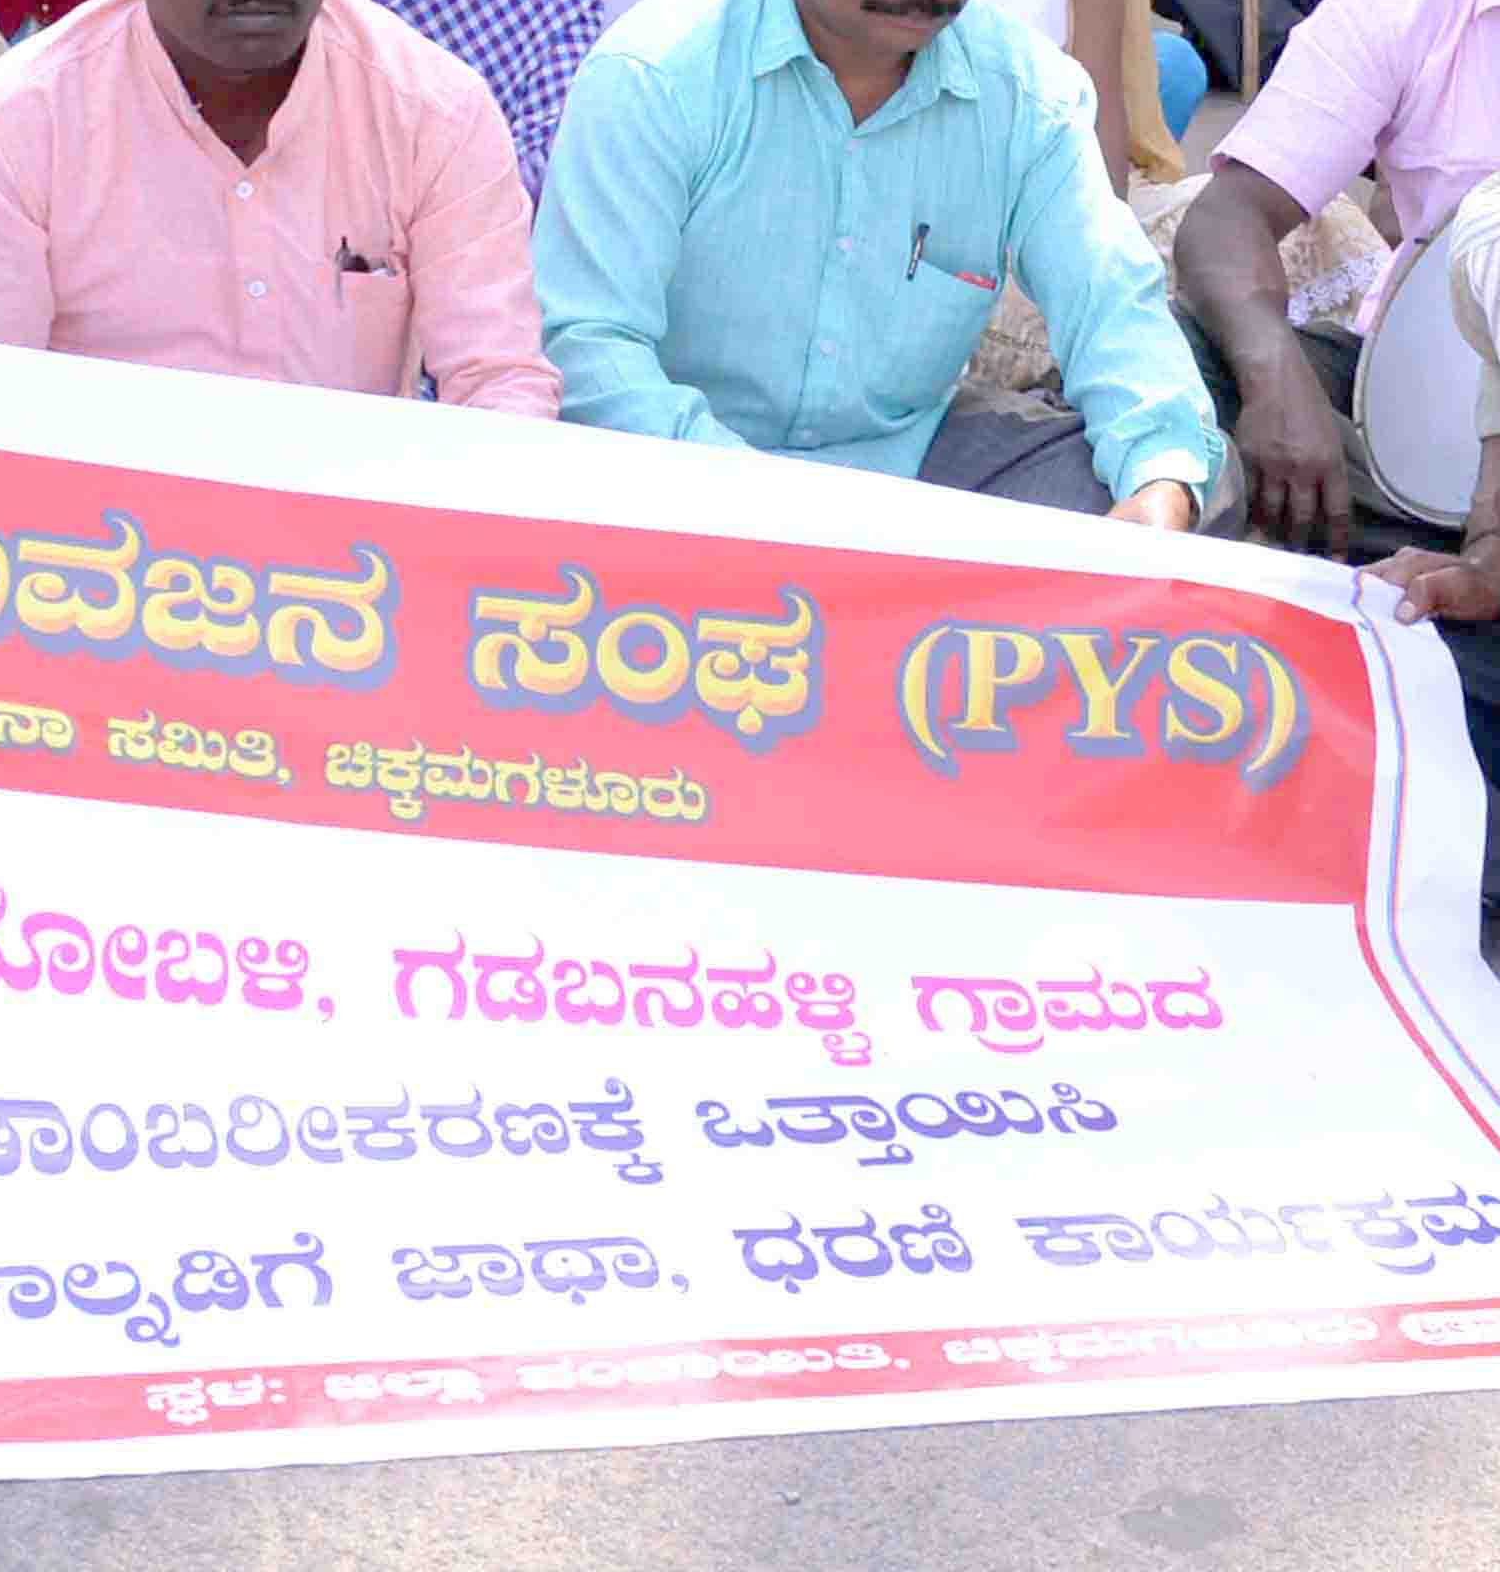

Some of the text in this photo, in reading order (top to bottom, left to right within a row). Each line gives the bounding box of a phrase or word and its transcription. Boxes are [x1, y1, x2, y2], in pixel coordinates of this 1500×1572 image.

[470, 568, 816, 738] ಸಂಘ
[900, 623, 1300, 774] (PYS)
[106, 708, 293, 786] ಸಮಿತಿ,
[324, 734, 708, 821] ಚಿಕ್ಕಮಗಳೂರು
[391, 926, 874, 1068] ಗಡಬನಹಳ್ಳಿ
[910, 962, 1225, 1054] ಗ್ರಾಮದ
[694, 1080, 1120, 1168] ಒತ್ತಾಯಿಸಿ
[391, 1235, 692, 1306] ಜಾಥಾ,
[732, 1203, 976, 1295] ಧರಣಿ
[145, 1372, 288, 1427] ಸ್ಥಳ:
